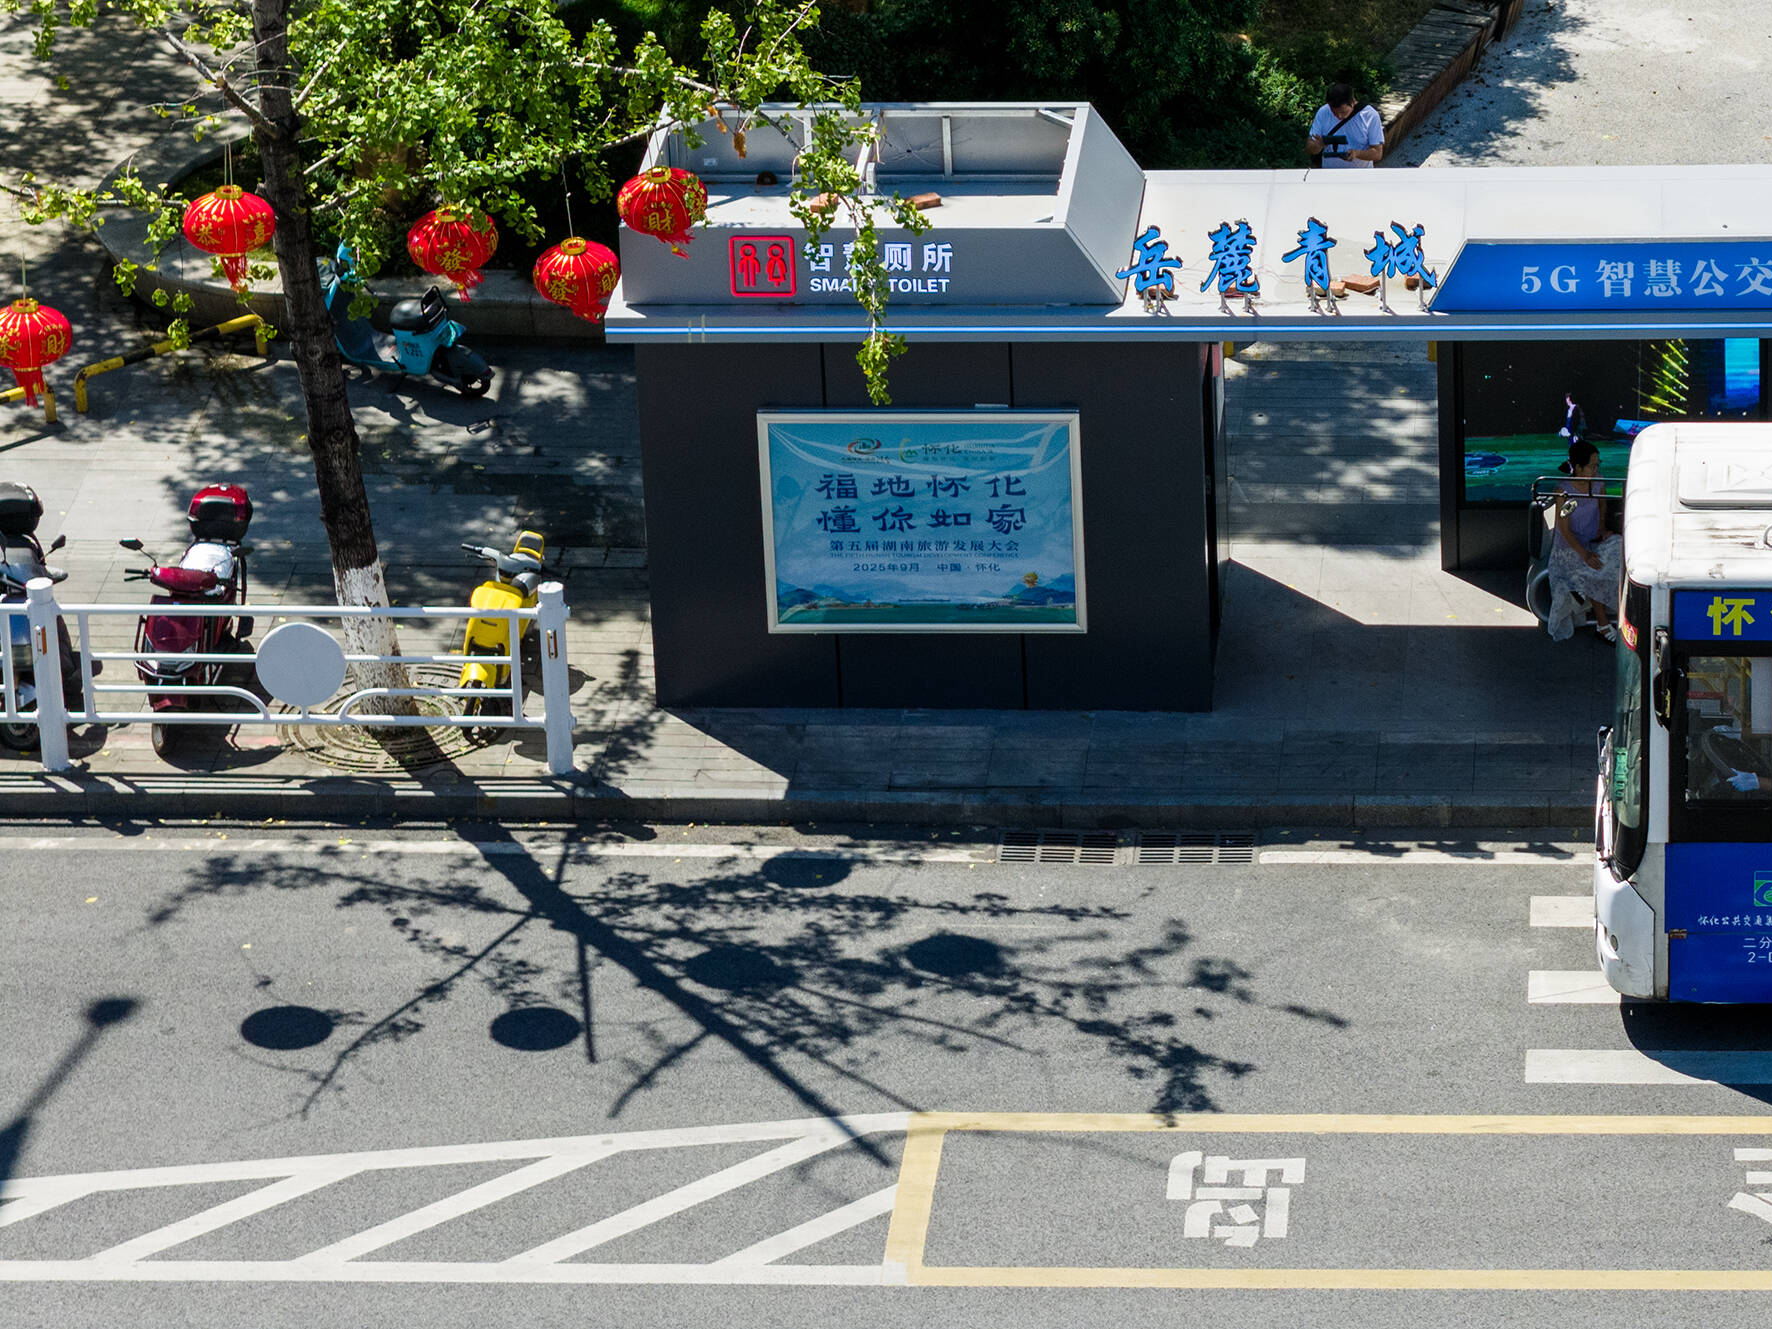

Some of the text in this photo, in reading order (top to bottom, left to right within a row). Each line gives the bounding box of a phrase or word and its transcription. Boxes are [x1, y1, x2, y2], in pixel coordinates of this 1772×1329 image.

[1116, 217, 1437, 292] 岳麓青城
[810, 278, 950, 292] SMA TOILET
[1521, 265, 1580, 294] 5G
[815, 474, 1026, 499] 福地怀化
[816, 504, 1026, 534] 懂你如家
[830, 540, 1019, 551] 第五届湖南旅游发展大会
[853, 563, 920, 572] 2025年9月
